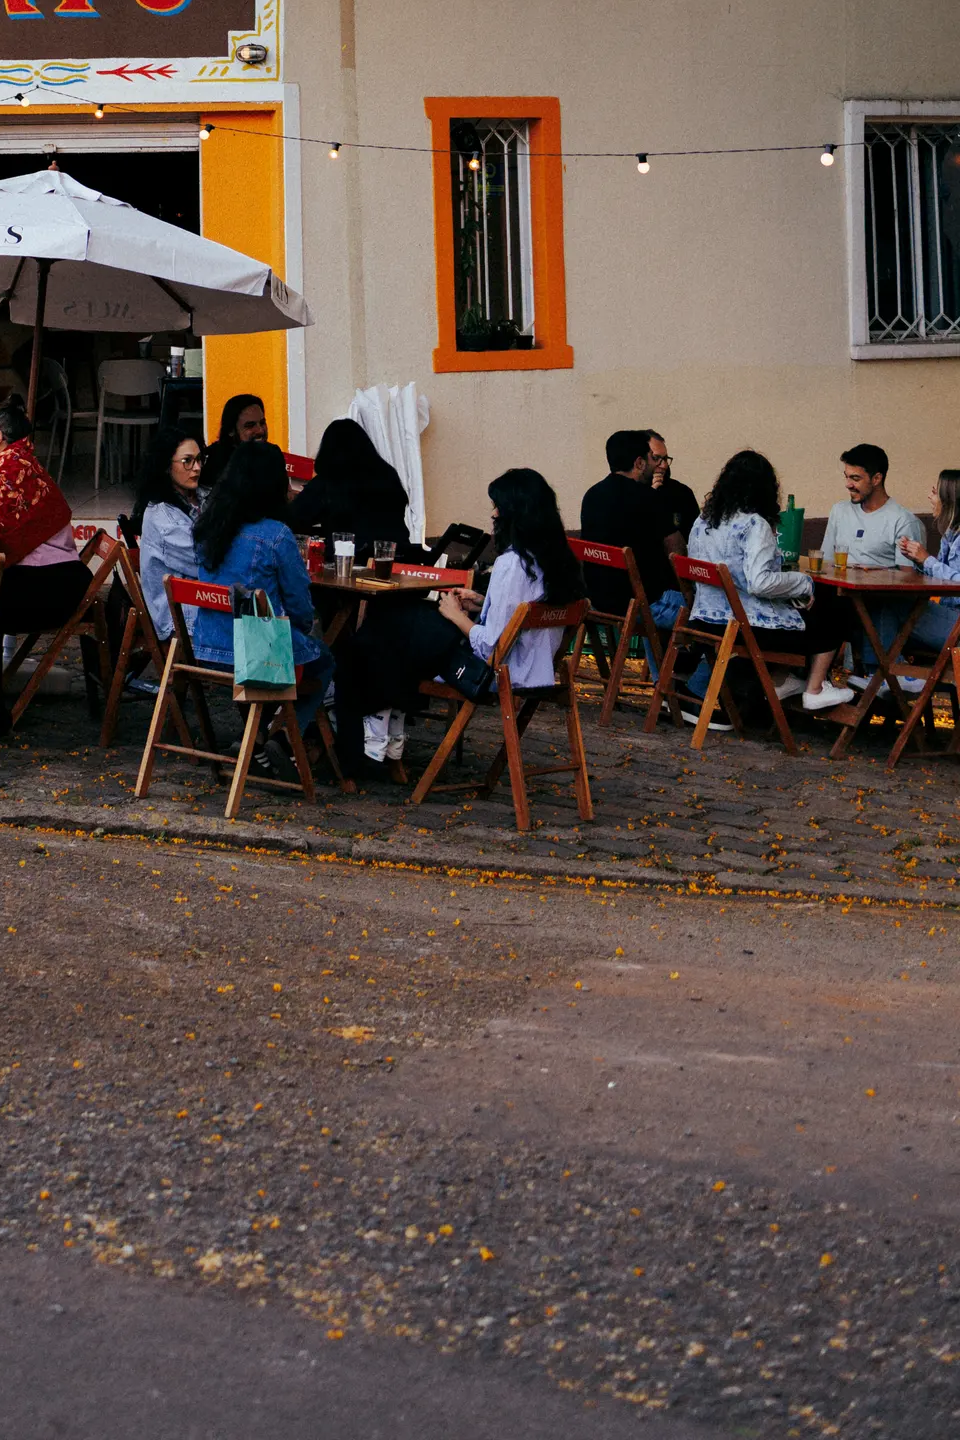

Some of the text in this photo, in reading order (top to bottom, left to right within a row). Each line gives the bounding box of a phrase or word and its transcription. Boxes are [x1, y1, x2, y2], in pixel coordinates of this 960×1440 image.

[583, 547, 611, 562] AMSTEL
[689, 565, 711, 579] AMSTEL
[540, 609, 568, 621] AMSTEL
